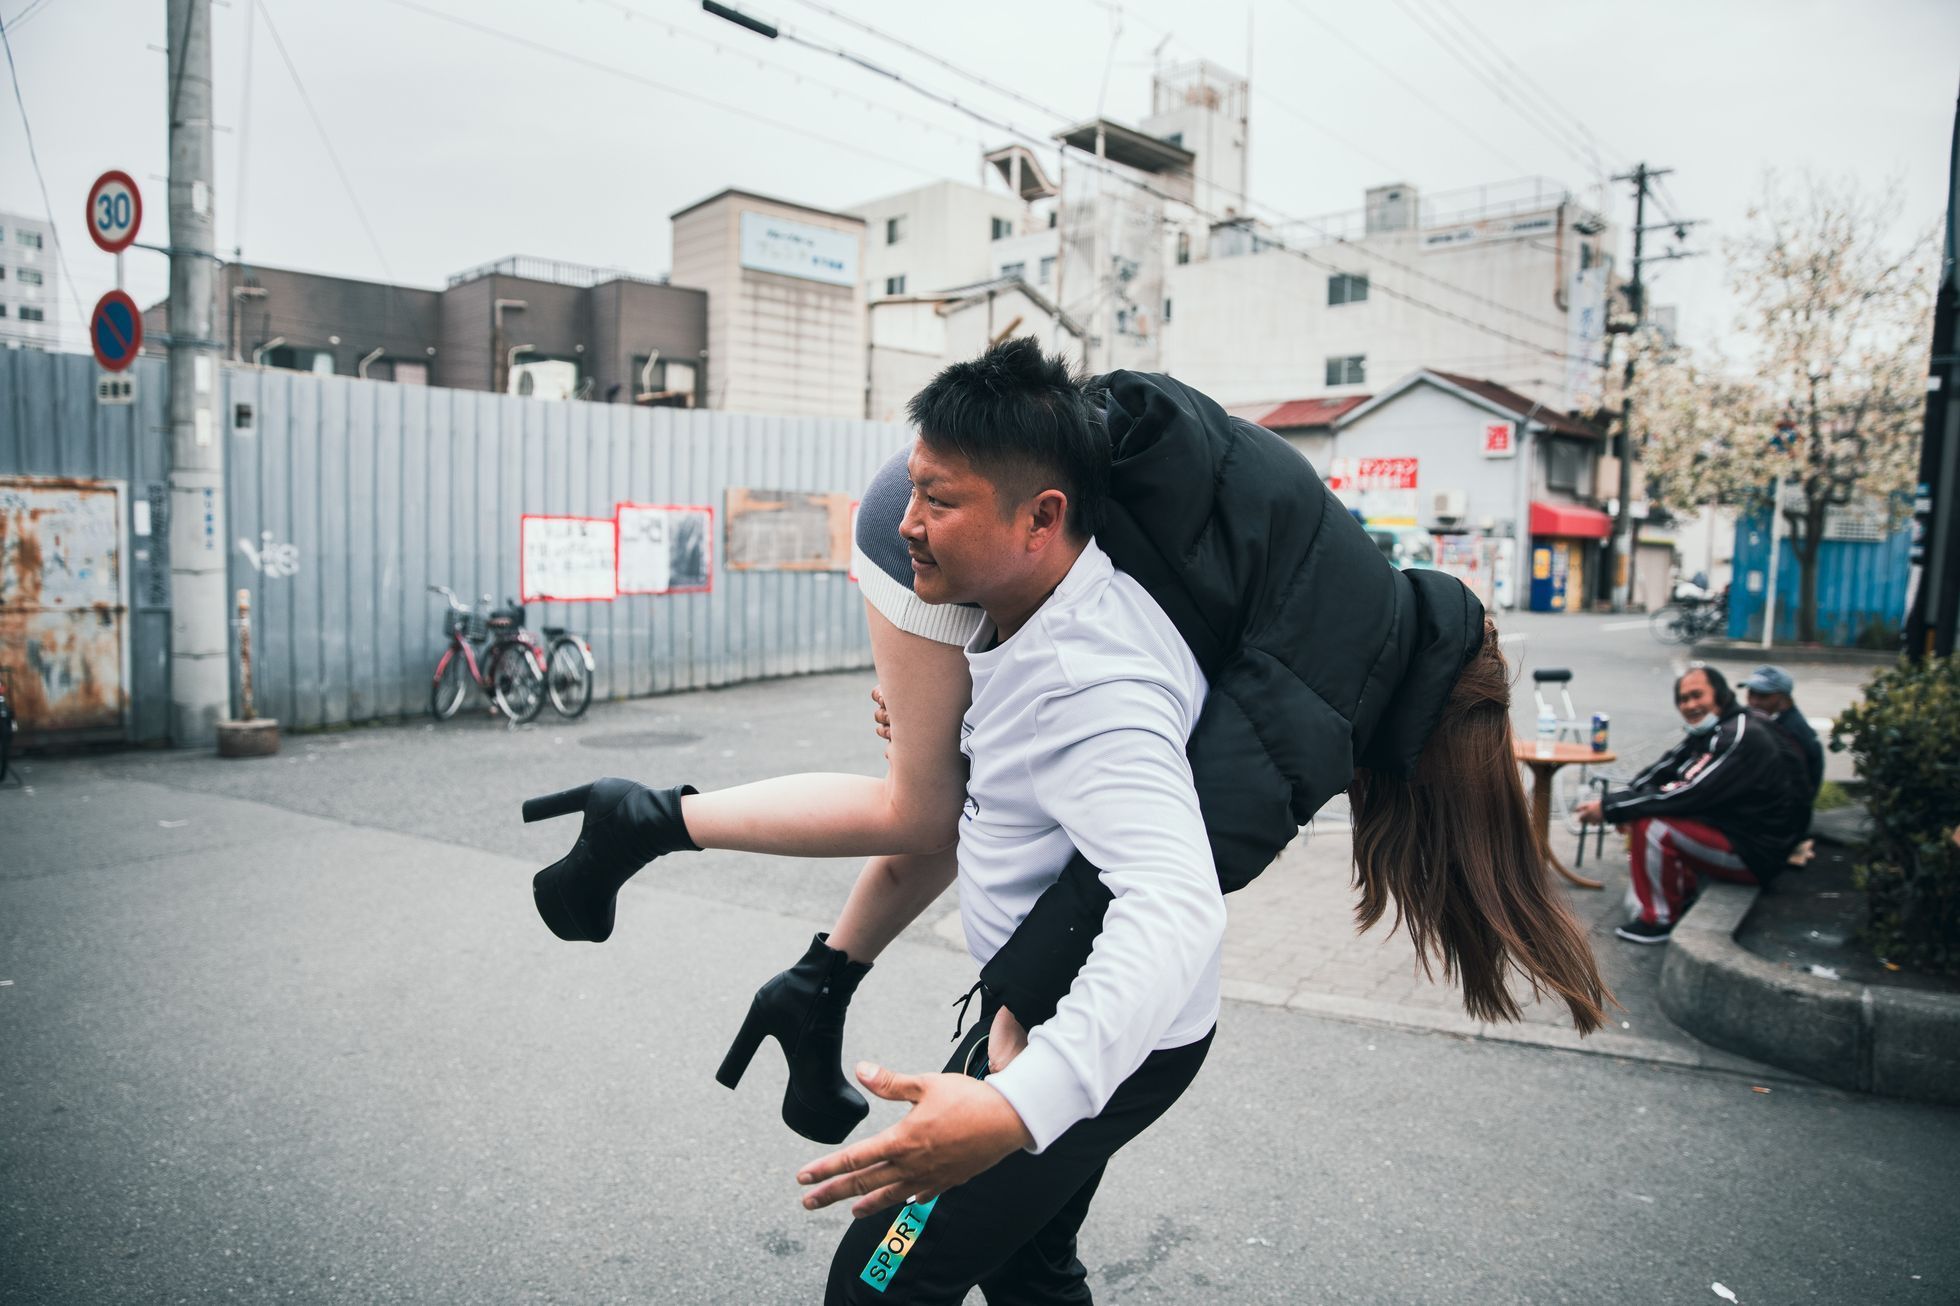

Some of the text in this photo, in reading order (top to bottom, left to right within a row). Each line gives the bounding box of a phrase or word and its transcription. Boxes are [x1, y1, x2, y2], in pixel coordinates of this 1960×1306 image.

[97, 191, 131, 231] 30
[1486, 425, 1509, 451] 酒
[869, 1207, 921, 1282] SPORT
